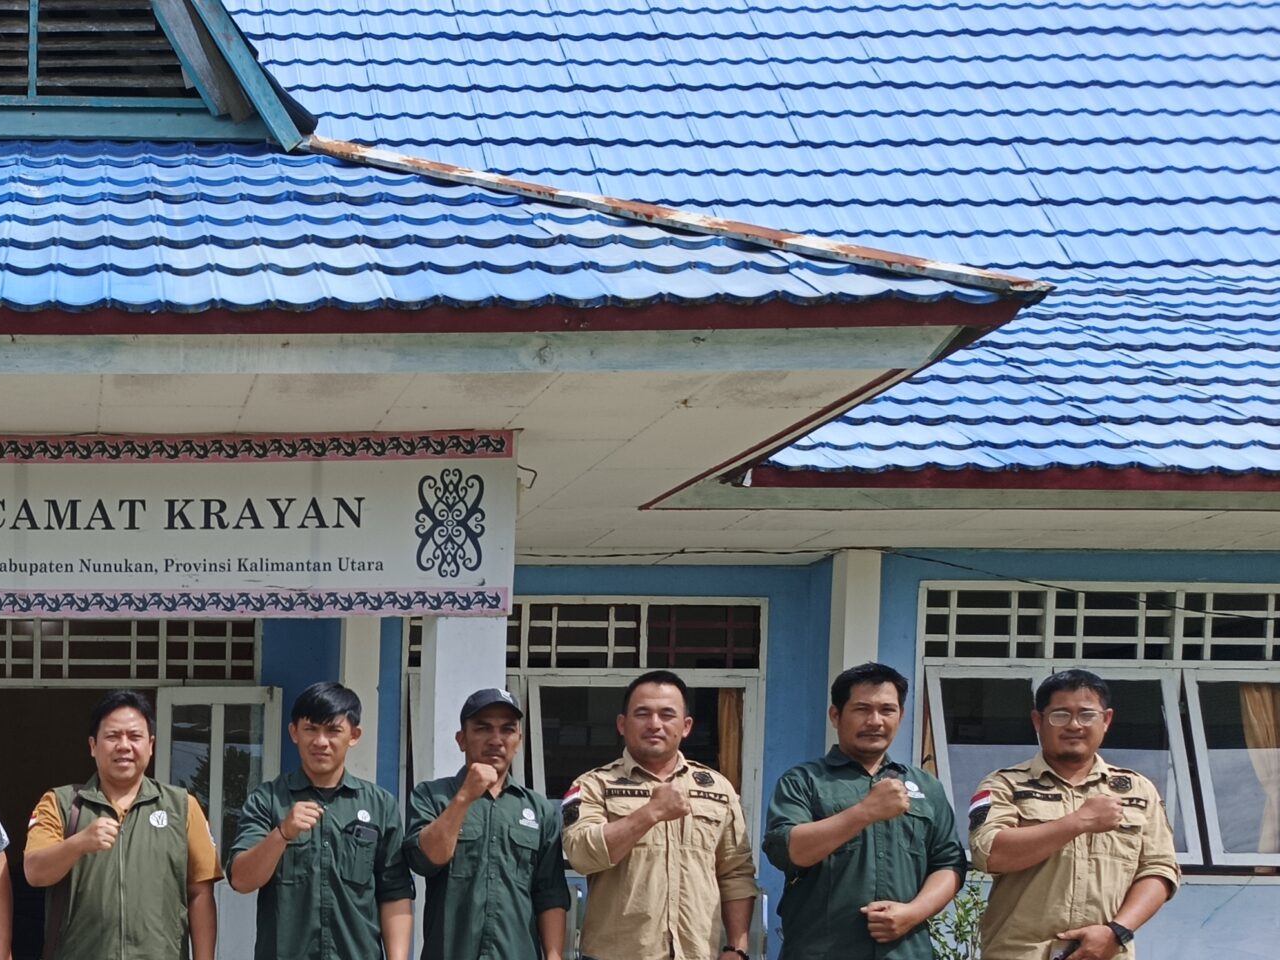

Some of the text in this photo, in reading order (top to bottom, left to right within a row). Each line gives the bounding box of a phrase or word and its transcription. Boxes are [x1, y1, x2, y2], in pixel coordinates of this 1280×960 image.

[163, 496, 366, 531] KRAYAN
[79, 558, 159, 575] Nunukan,
[163, 558, 232, 573] Provinsi
[237, 557, 332, 573] Kalimantan
[337, 556, 384, 572] Utara
